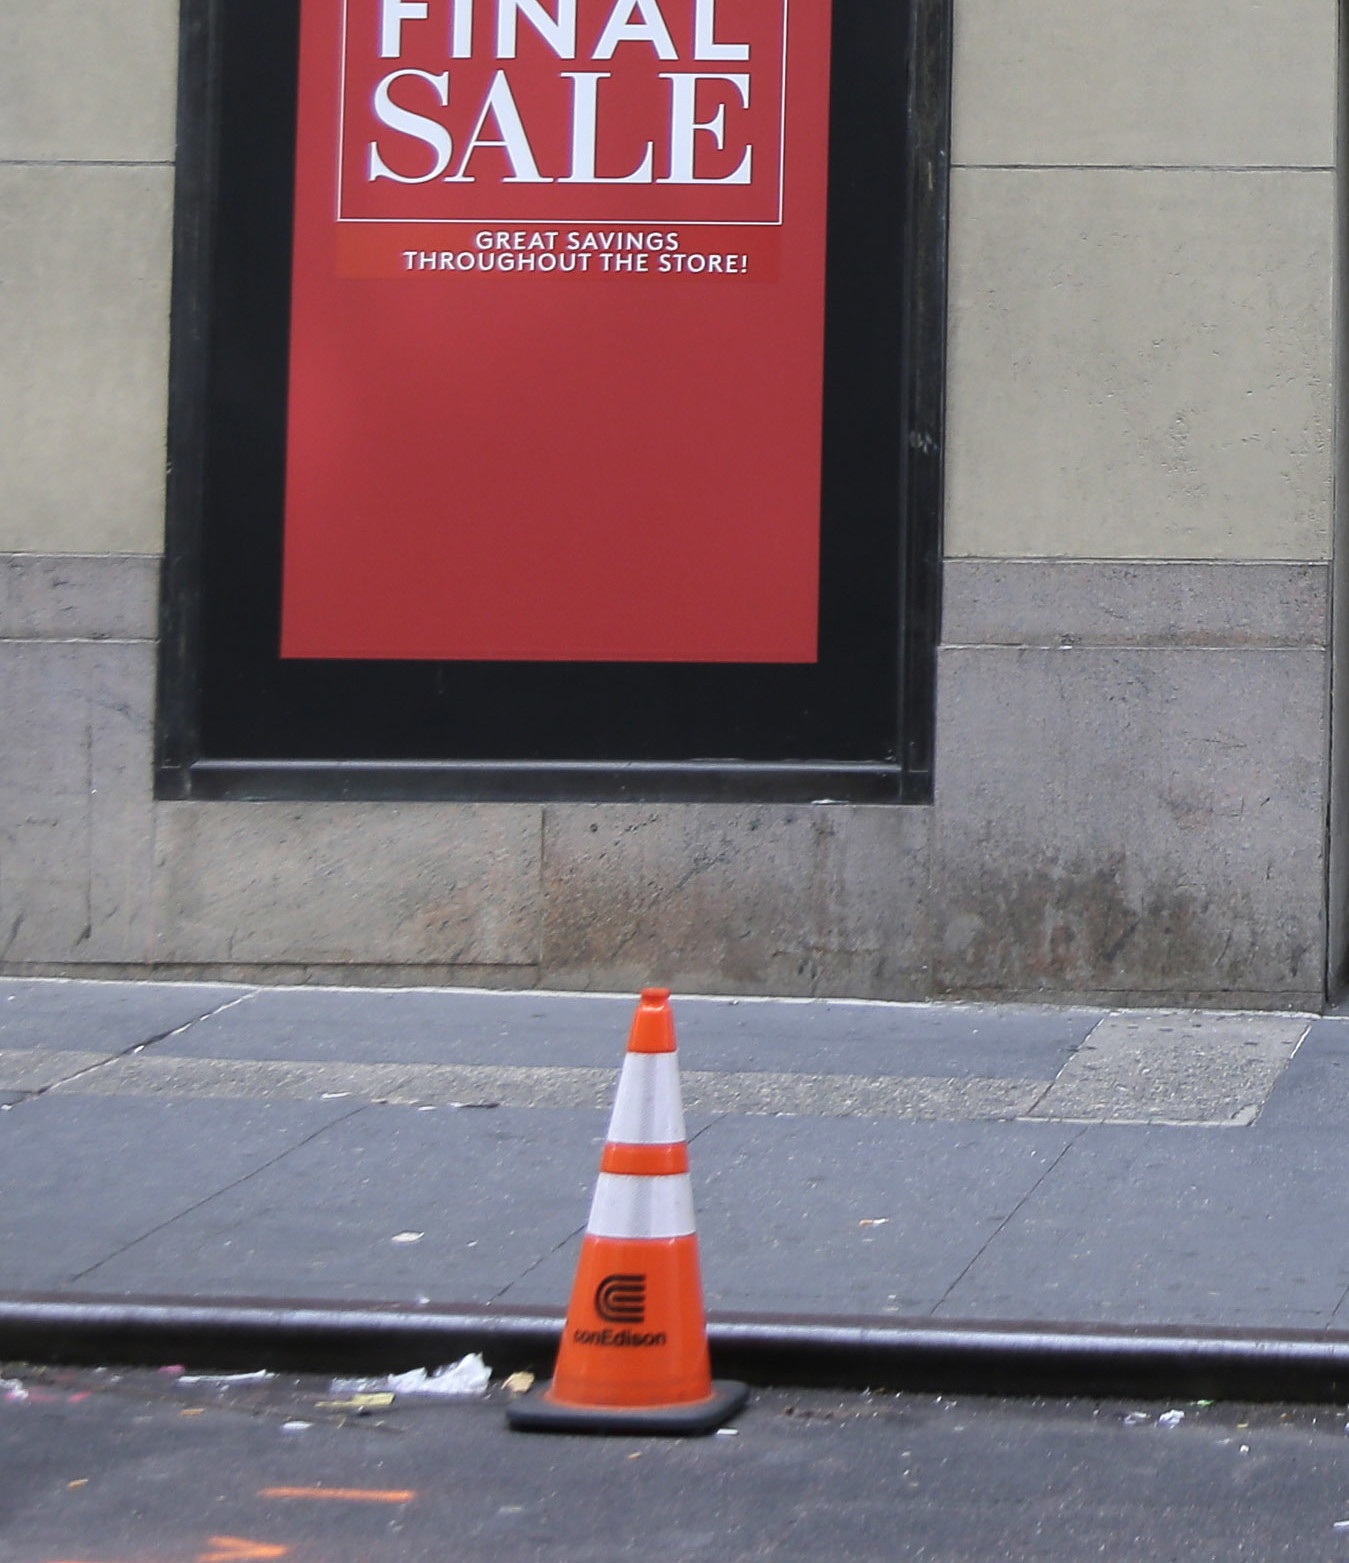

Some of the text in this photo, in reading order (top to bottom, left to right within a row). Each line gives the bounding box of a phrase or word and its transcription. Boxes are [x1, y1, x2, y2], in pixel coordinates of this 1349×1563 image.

[367, 68, 753, 186] SALE
[475, 230, 680, 252] GREAT SAVINGS
[401, 251, 749, 275] THROUGHOUT THE STORE!
[573, 1328, 667, 1348] conEdison
